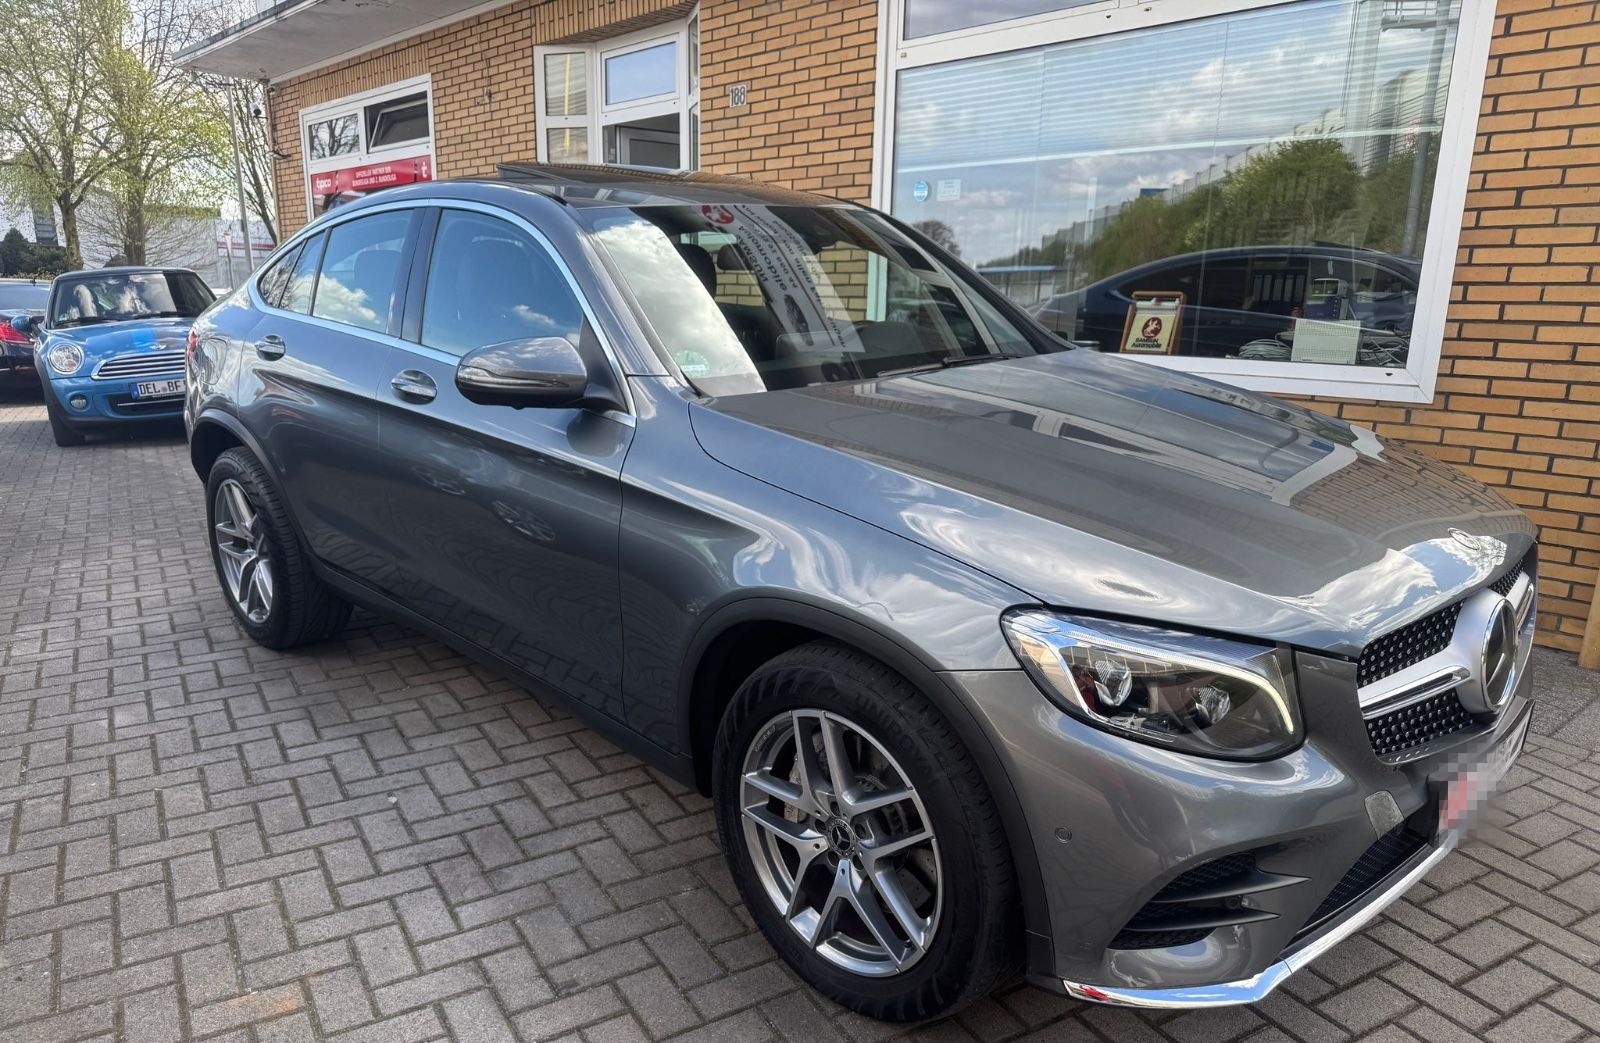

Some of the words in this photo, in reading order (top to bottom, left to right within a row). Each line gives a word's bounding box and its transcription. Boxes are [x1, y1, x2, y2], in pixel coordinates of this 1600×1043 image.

[731, 86, 746, 106] 188
[139, 383, 161, 395] DEL
[167, 381, 181, 392] BF
